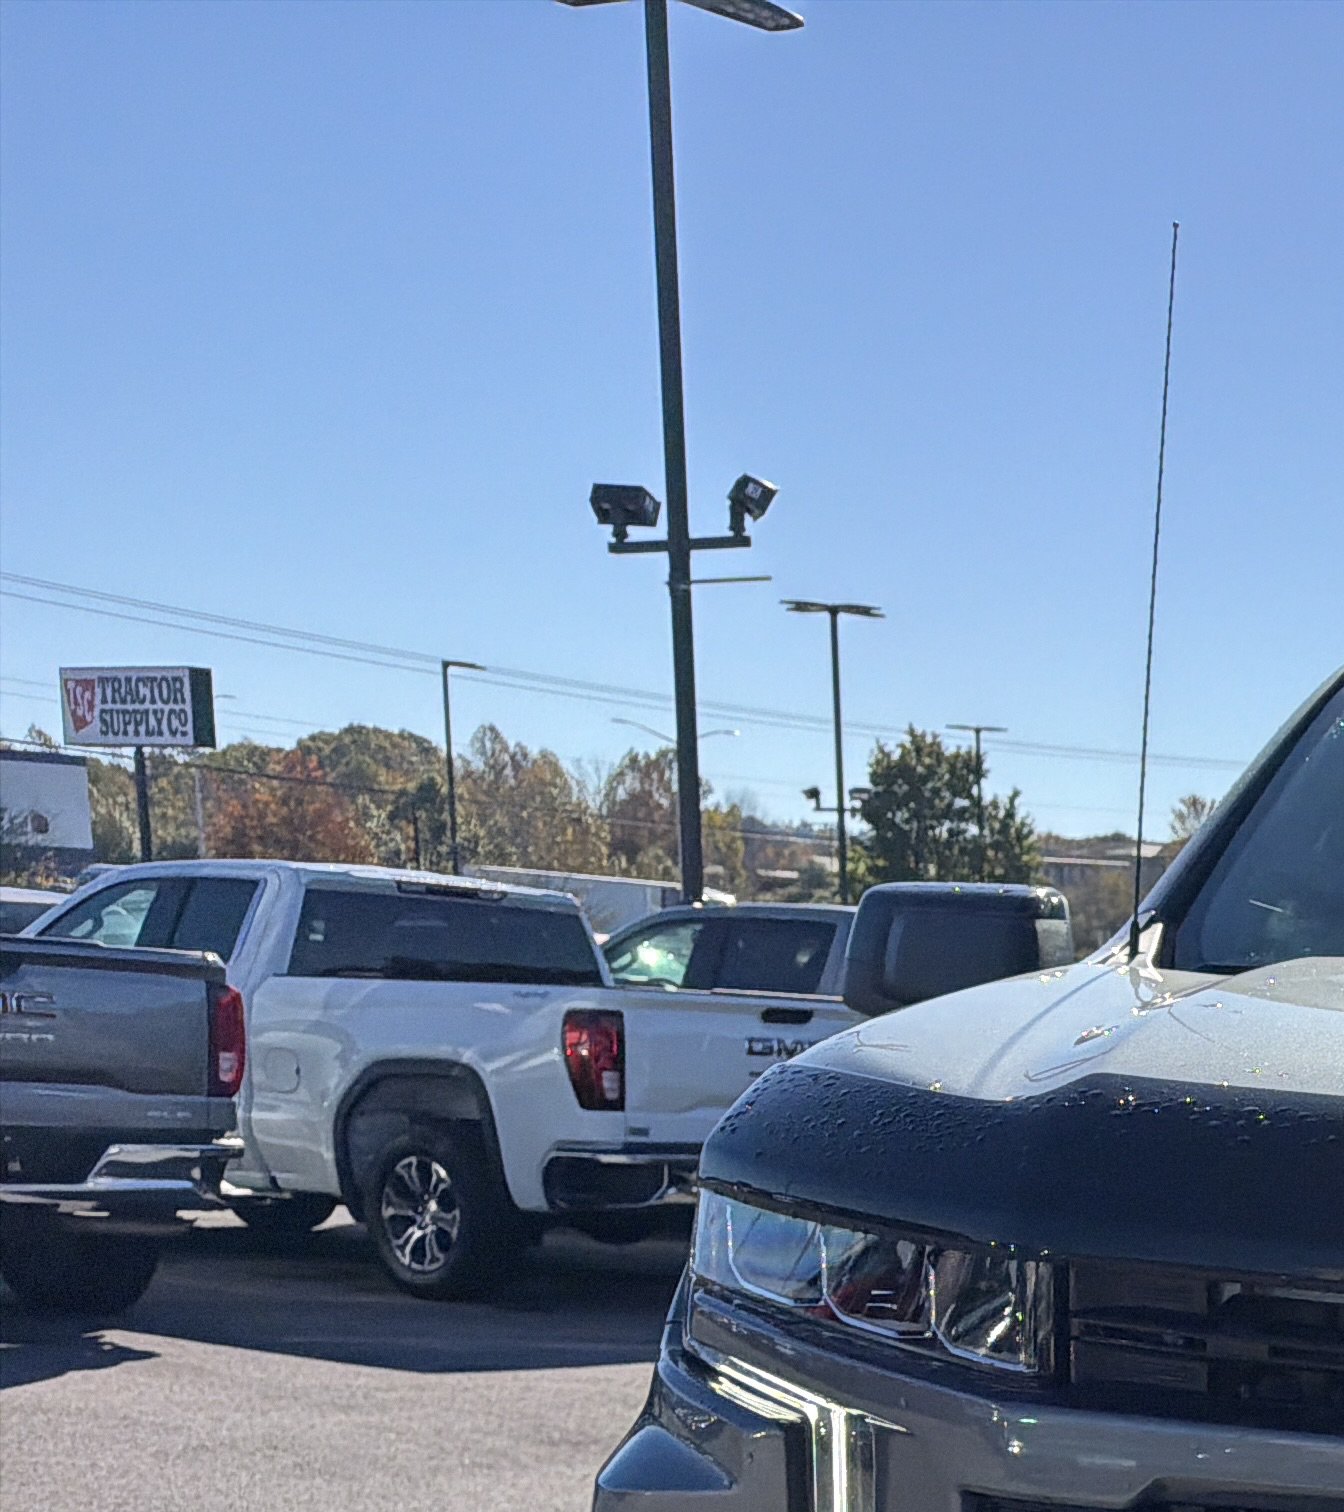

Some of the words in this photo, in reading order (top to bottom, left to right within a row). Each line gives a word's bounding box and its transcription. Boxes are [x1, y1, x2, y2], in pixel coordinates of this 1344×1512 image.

[67, 680, 93, 722] TSC
[98, 676, 187, 705] TRACTOR
[100, 708, 165, 737] SUPPLY
